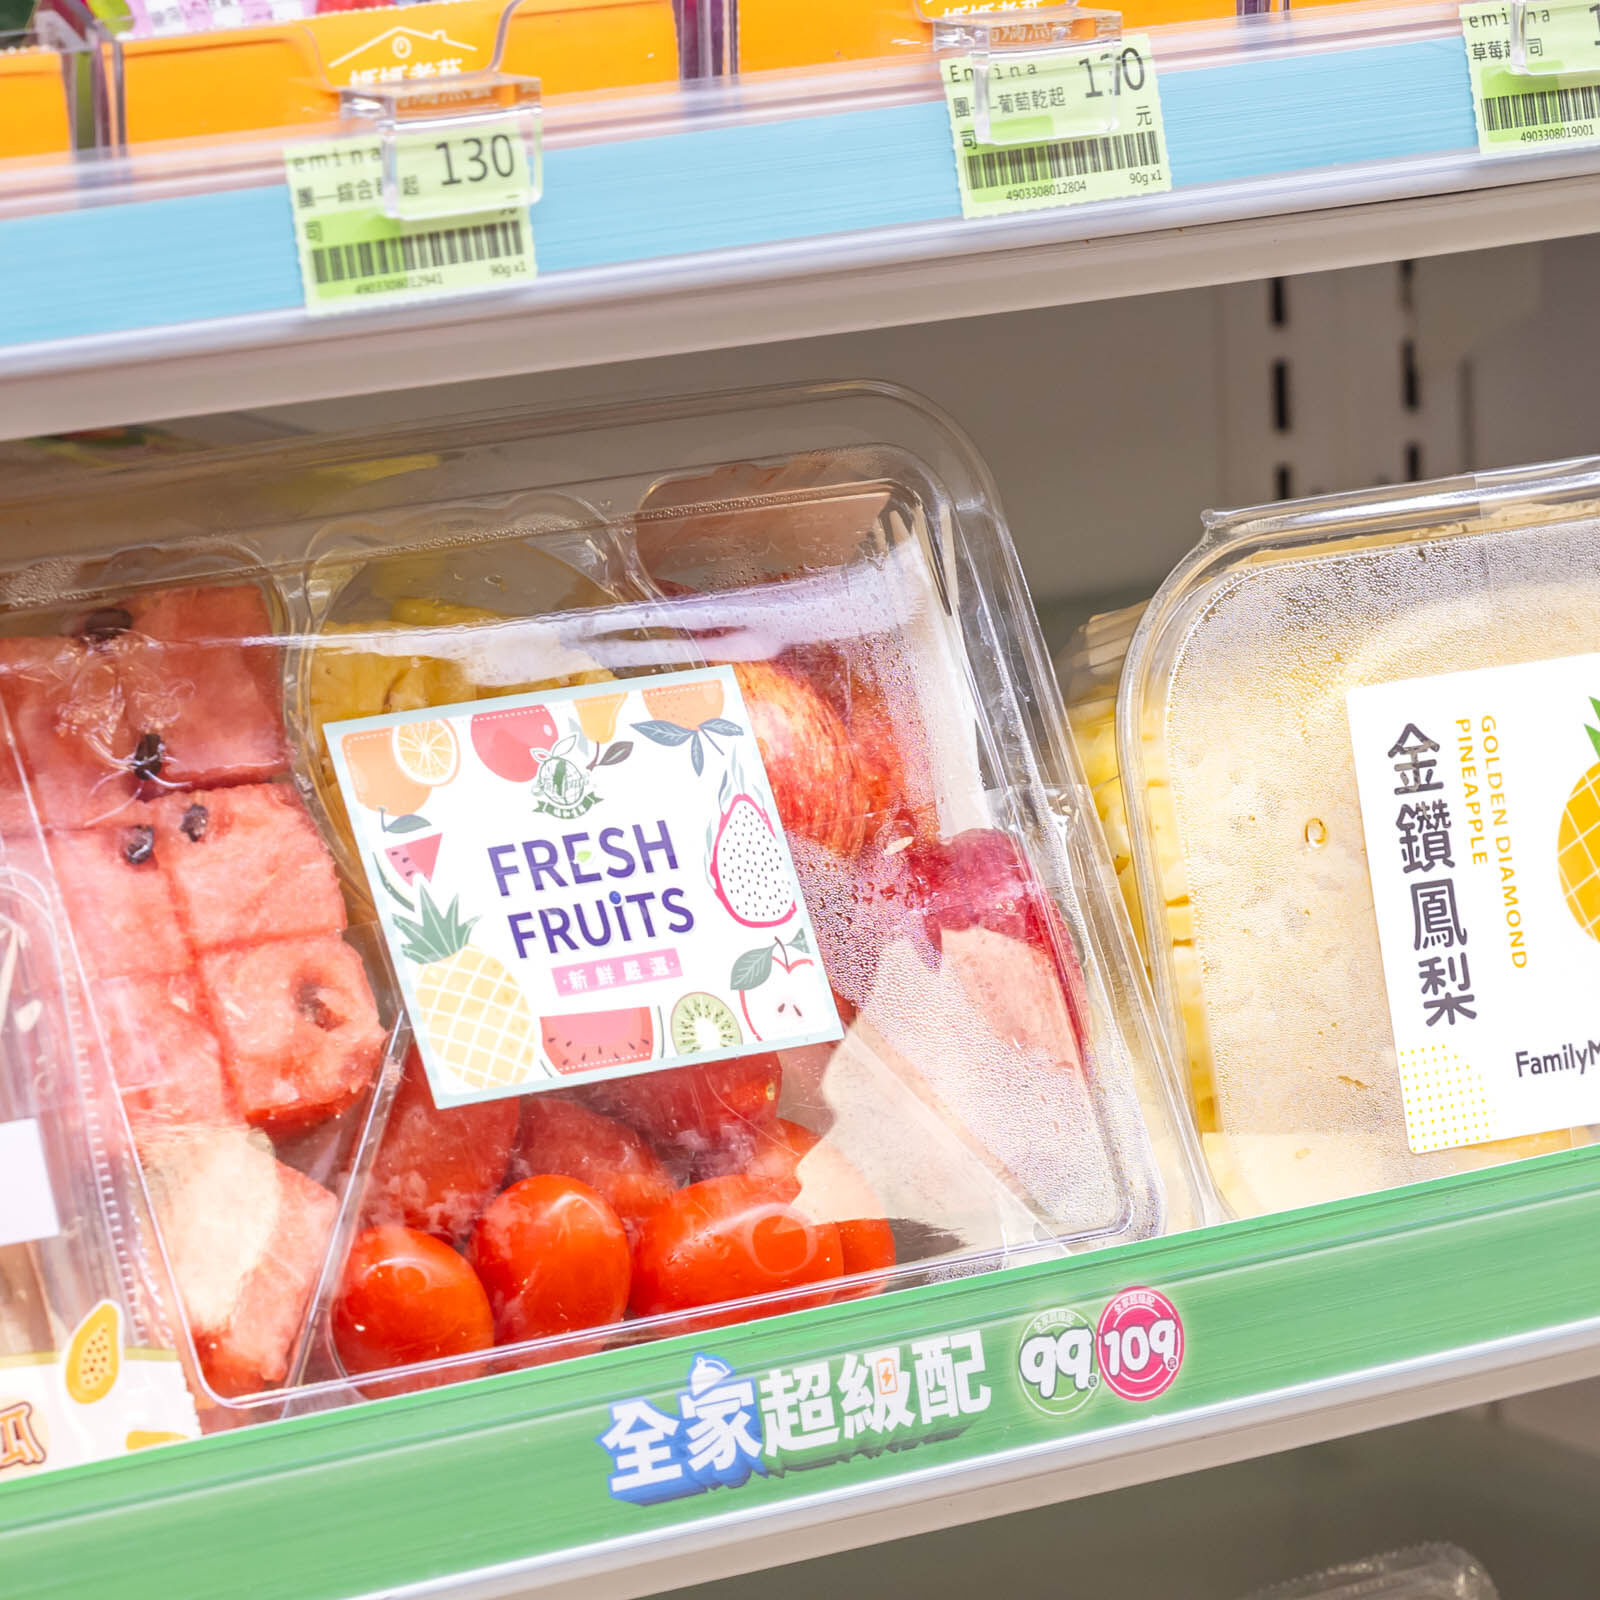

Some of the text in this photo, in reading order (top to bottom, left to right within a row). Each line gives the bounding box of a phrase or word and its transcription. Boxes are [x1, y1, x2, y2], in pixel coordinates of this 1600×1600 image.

[953, 86, 1066, 119] 團葡萄乾起
[1135, 105, 1152, 127] 元
[1520, 124, 1594, 143] 4903308019001
[435, 133, 515, 187] 130
[1006, 180, 1087, 201] 4903308012804
[1129, 172, 1149, 186] 90g
[1455, 718, 1488, 866] PINEAPPLE
[487, 820, 679, 897] FRESH
[1387, 722, 1477, 1027] 金鑽鳳梨
[1480, 715, 1528, 969] GOLDEN DIAMOND
[508, 887, 694, 959] FRUITS
[1020, 1317, 1179, 1400] 99 109
[602, 1330, 992, 1494] 全家超級配
